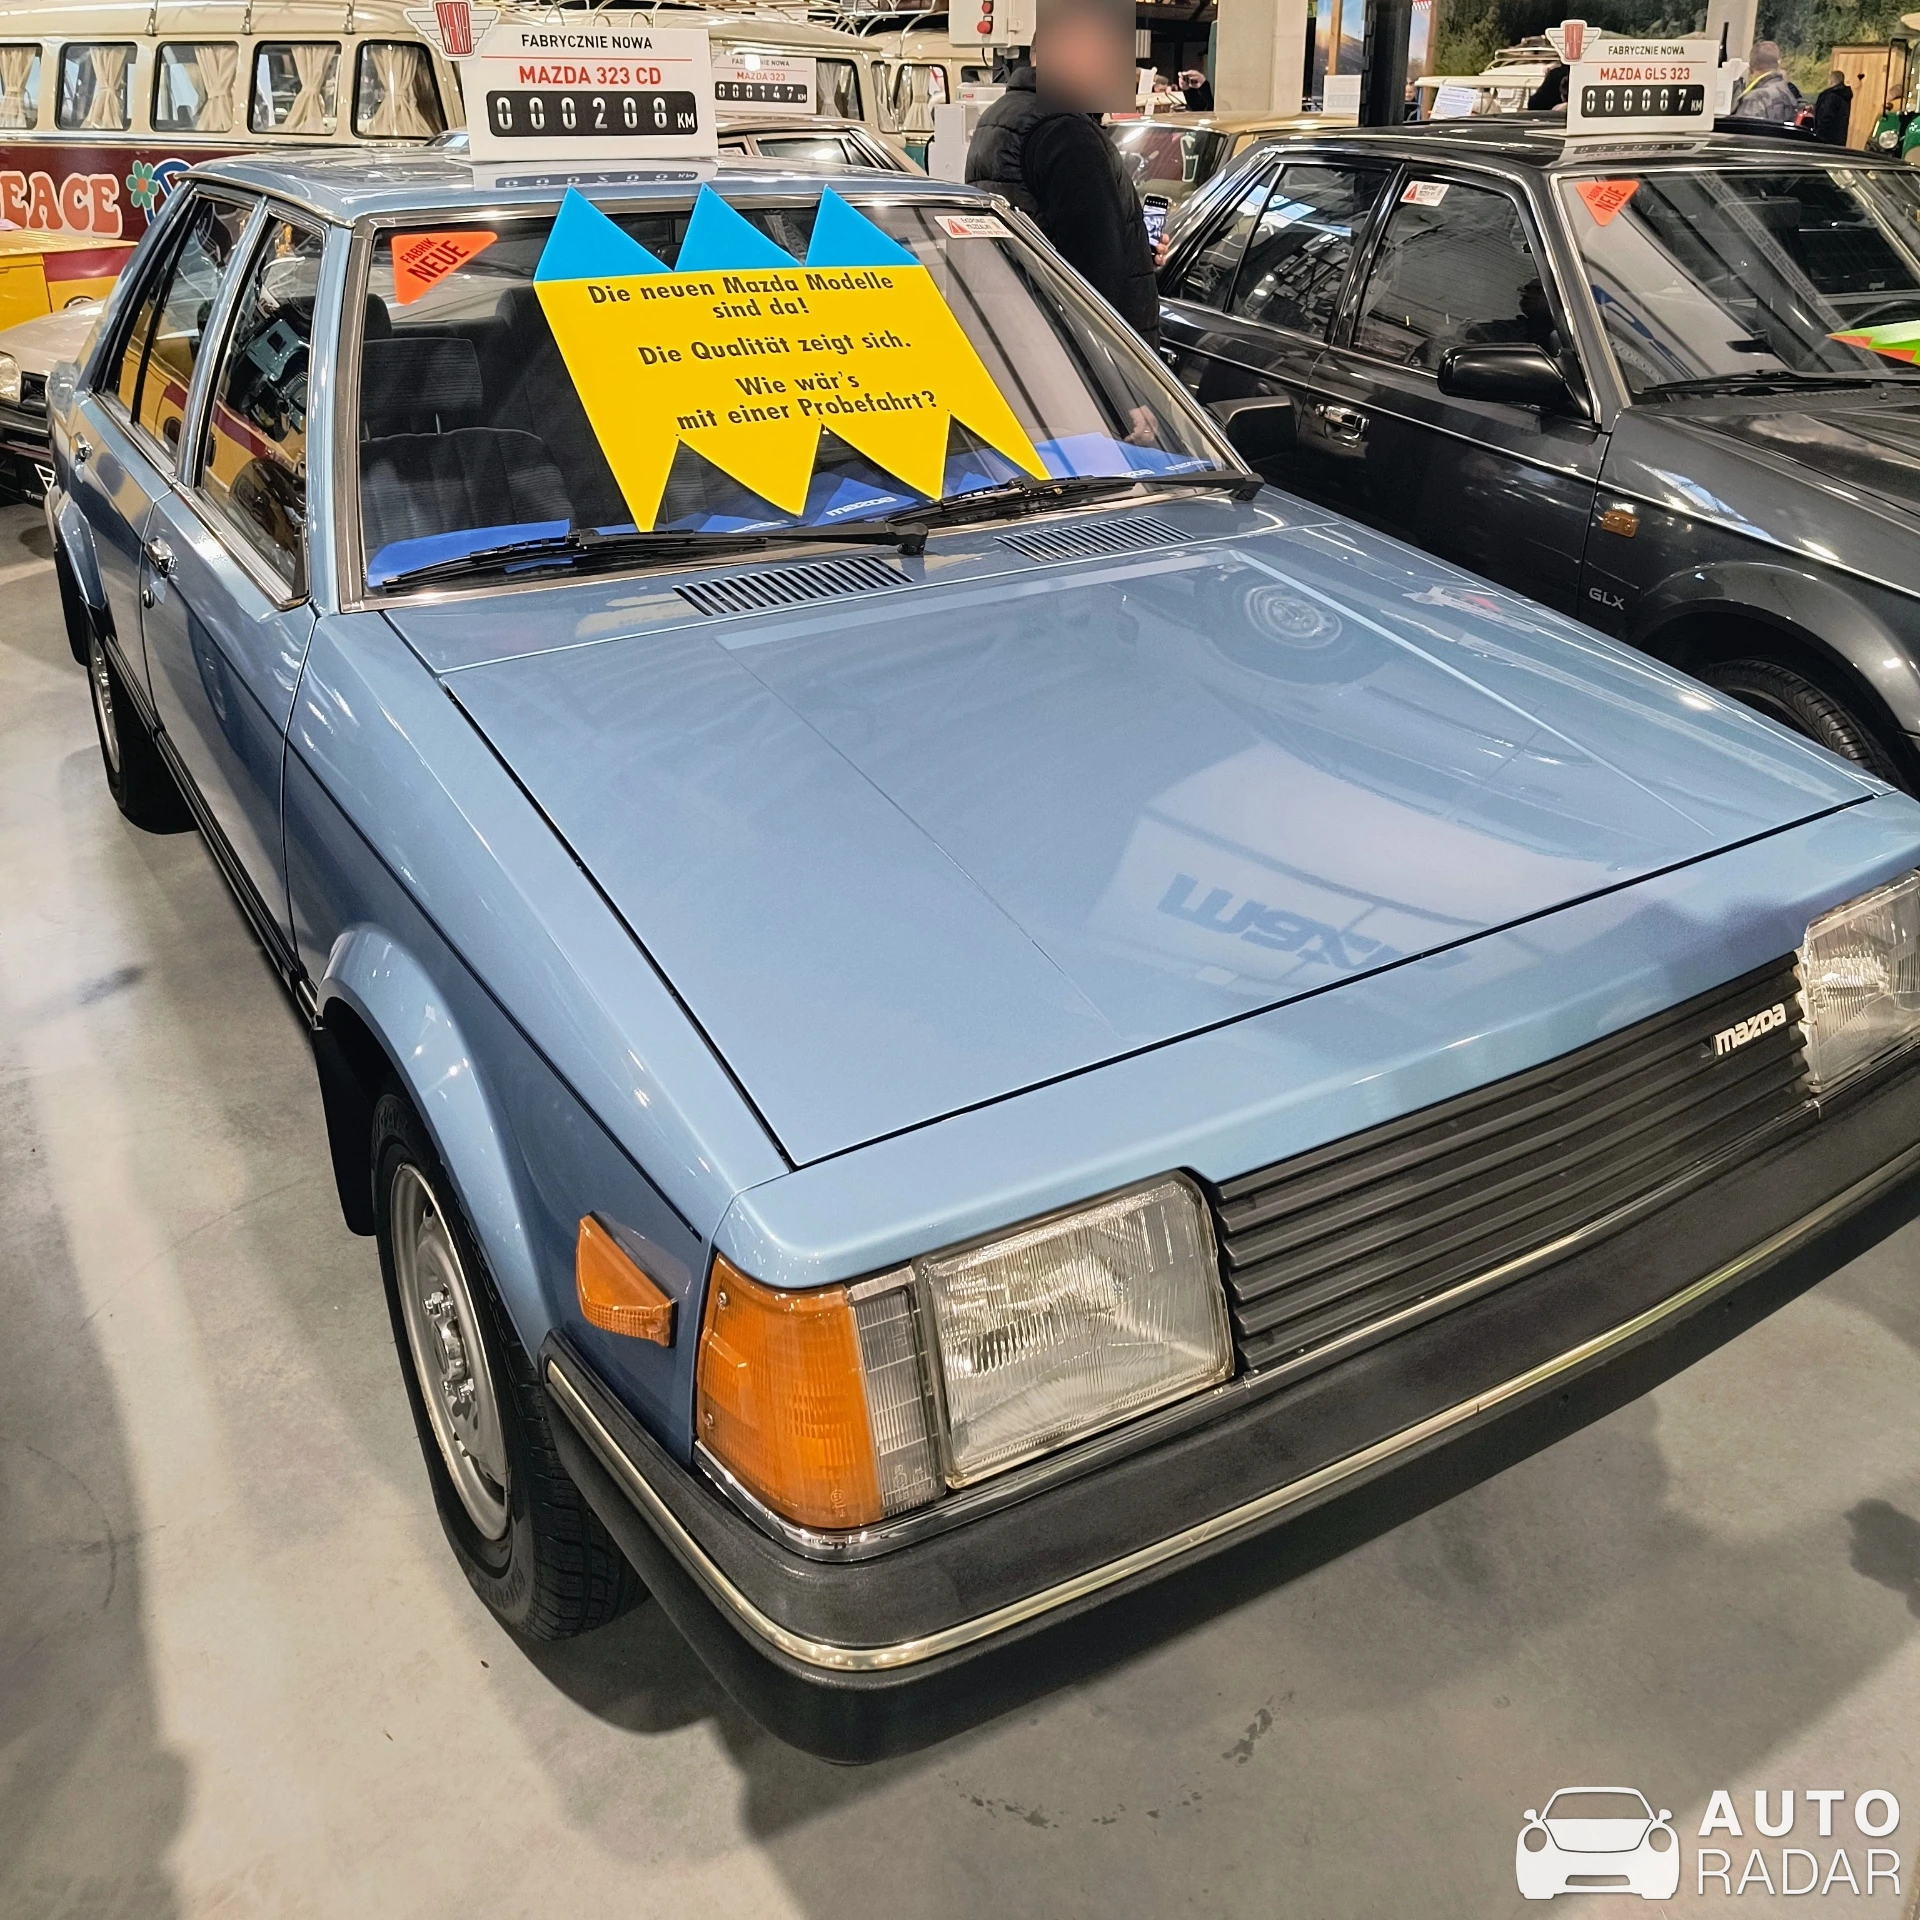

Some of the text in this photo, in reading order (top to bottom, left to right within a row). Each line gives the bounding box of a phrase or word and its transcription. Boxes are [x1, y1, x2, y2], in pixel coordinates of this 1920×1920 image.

[521, 34, 653, 49] FABRYCZNIE NOWA
[1608, 45, 1685, 55] FABRYCZNIE NOWA
[519, 65, 662, 85] MAZDA 323 CD
[736, 71, 786, 82] MAZDA 323
[1600, 67, 1690, 80] MAZDA GLS 323
[797, 93, 807, 101] KM
[1690, 99, 1703, 112] KM
[676, 112, 696, 130] KM
[0, 173, 121, 236] EACE
[1594, 186, 1627, 213] NEUE
[399, 237, 439, 264] FABRIK
[406, 240, 470, 284] NEUE
[587, 271, 894, 304] Die neuen Mazda Modelle
[712, 297, 810, 319] sind da!
[637, 330, 912, 366] Die Qualität zeigt sich.
[735, 370, 860, 396] Wie wär's
[676, 390, 937, 430] mit einer Probefahrt?
[825, 496, 898, 517] mazda
[1588, 587, 1625, 610] GLX
[1713, 1002, 1787, 1056] mazda
